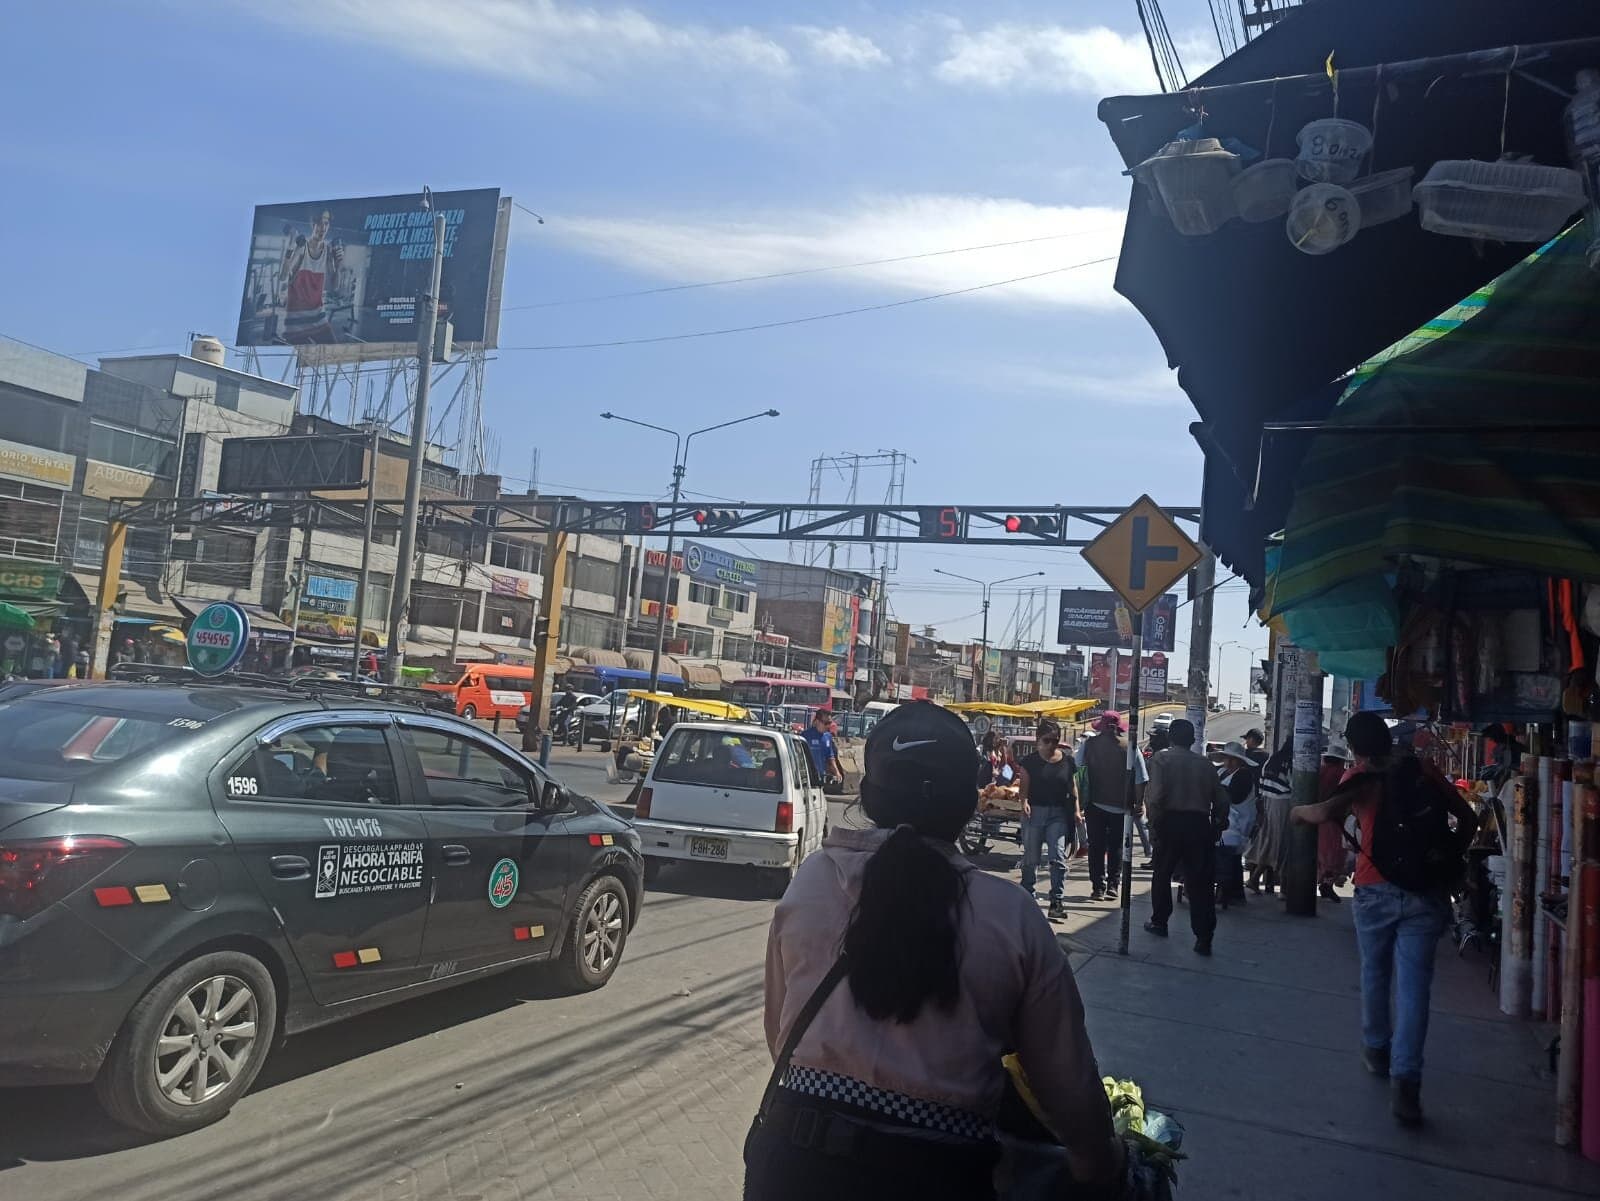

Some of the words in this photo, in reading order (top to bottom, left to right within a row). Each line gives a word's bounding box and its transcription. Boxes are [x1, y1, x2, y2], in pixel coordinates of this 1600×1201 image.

[1311, 134, 1323, 156] 8
[368, 229, 383, 245] NO
[383, 229, 397, 244] ES
[396, 228, 409, 244] AL
[400, 244, 435, 259] CAFETA
[31, 456, 71, 472] DENTAL
[940, 508, 955, 537] 5
[196, 631, 232, 646] 454545
[167, 717, 207, 730] 1596
[227, 776, 258, 795] 1596
[343, 844, 379, 854] DESCARGA
[380, 844, 389, 852] LA
[390, 843, 402, 852] APP
[342, 852, 386, 869] AHORA
[387, 850, 424, 866] TARIFA
[340, 865, 424, 886] NEGOCIABLE
[493, 871, 514, 900] 45
